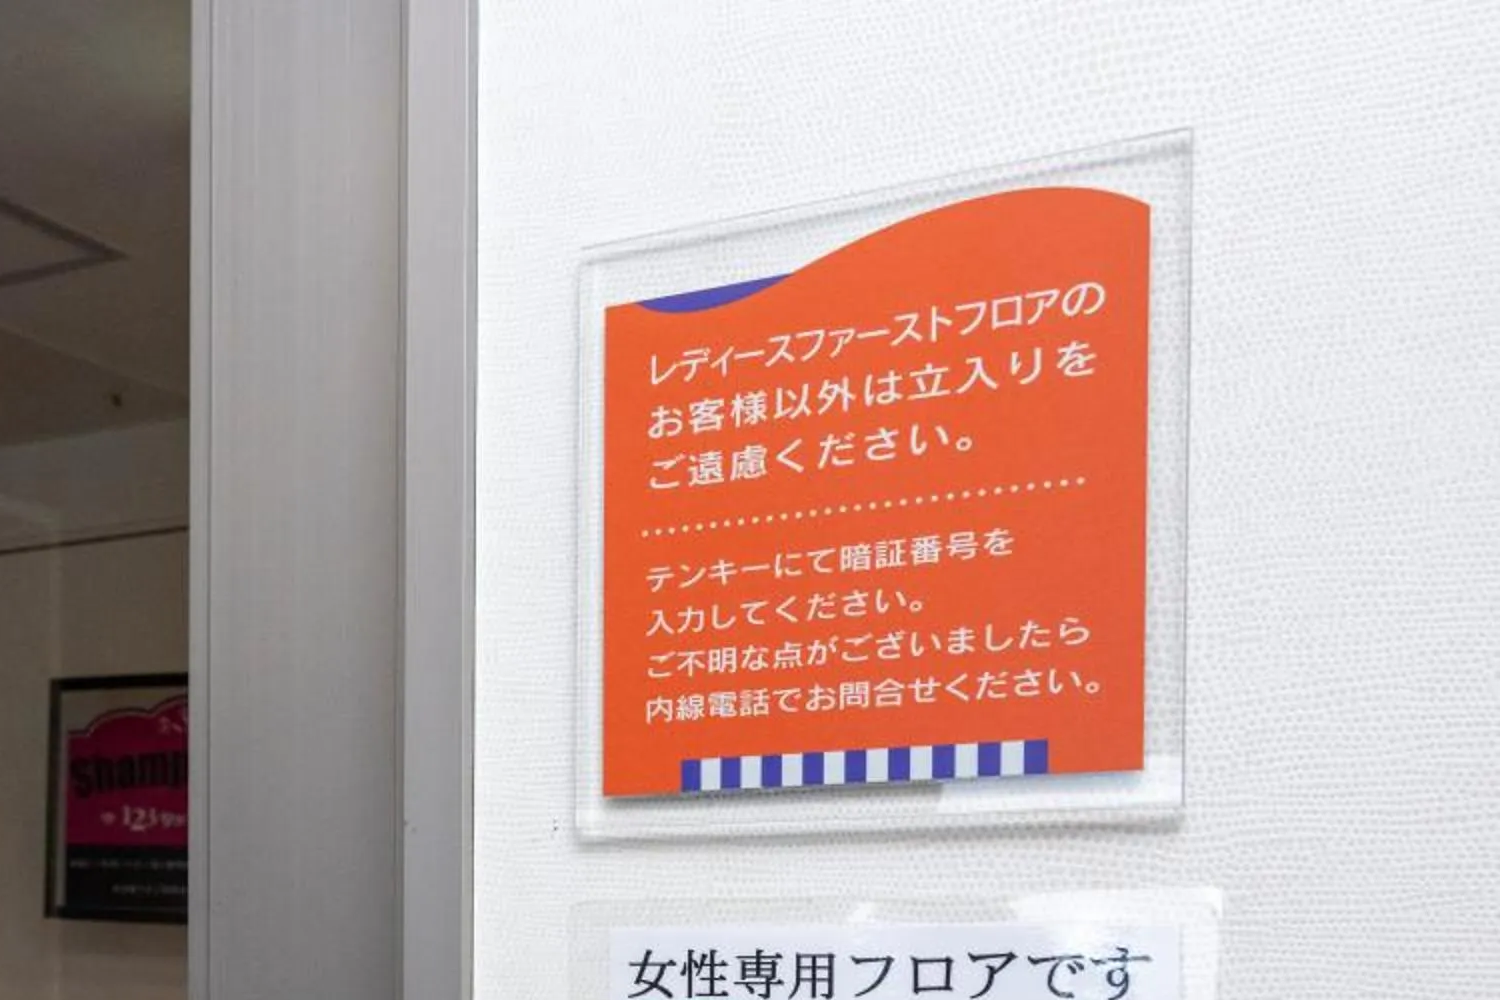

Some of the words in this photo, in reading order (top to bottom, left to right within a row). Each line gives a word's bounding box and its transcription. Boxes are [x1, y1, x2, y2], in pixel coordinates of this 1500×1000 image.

[650, 281, 1106, 387] レディースファーストフロアの
[647, 341, 1098, 440] お客様以外は立入りを
[649, 422, 975, 491] ご遠慮ください。
[645, 527, 1016, 594] テンキーにて暗証番号を
[645, 588, 927, 638] 入力してください。
[645, 616, 1092, 680] ご不明な点がございましたら
[645, 669, 1102, 725] 内線電話でお問合せください。
